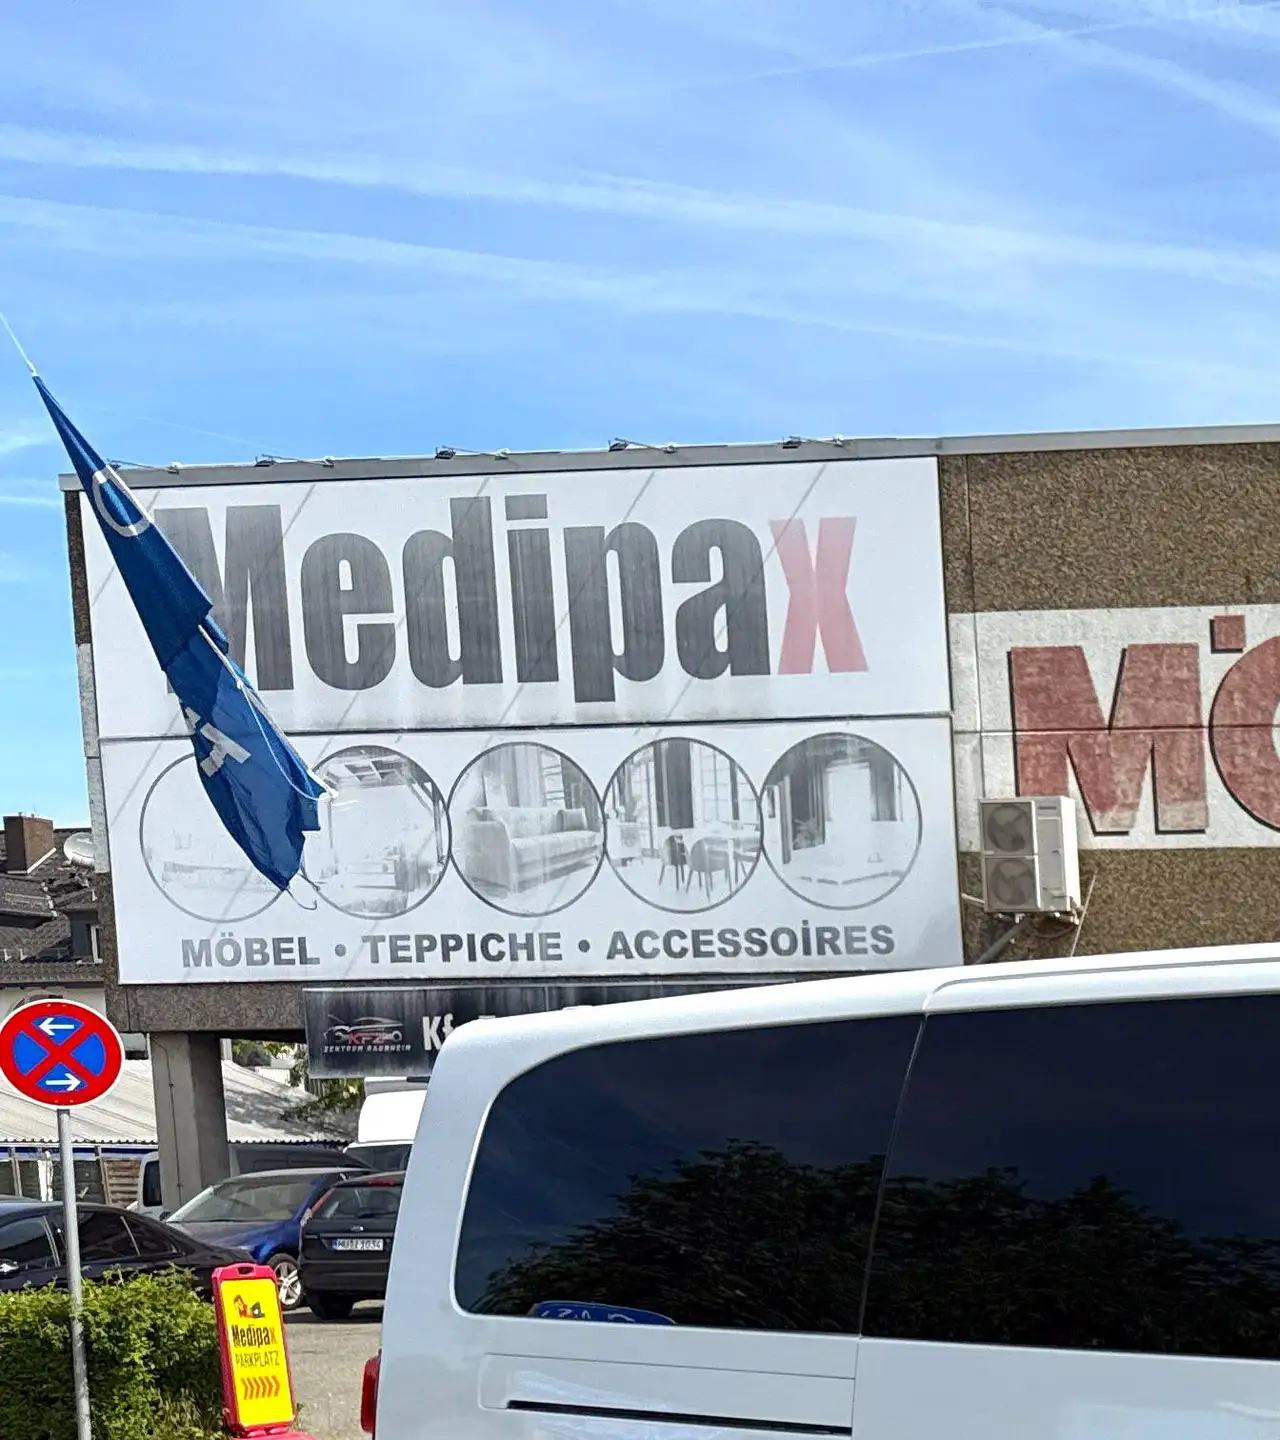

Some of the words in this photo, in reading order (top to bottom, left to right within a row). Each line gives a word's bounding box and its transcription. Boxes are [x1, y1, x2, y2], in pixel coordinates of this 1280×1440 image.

[153, 493, 869, 703] Medipax
[181, 931, 320, 968] MÖBEL
[363, 930, 563, 966] TEPPICHE
[231, 1324, 277, 1348] Medipax
[235, 1350, 280, 1367] PARKPLATZ
